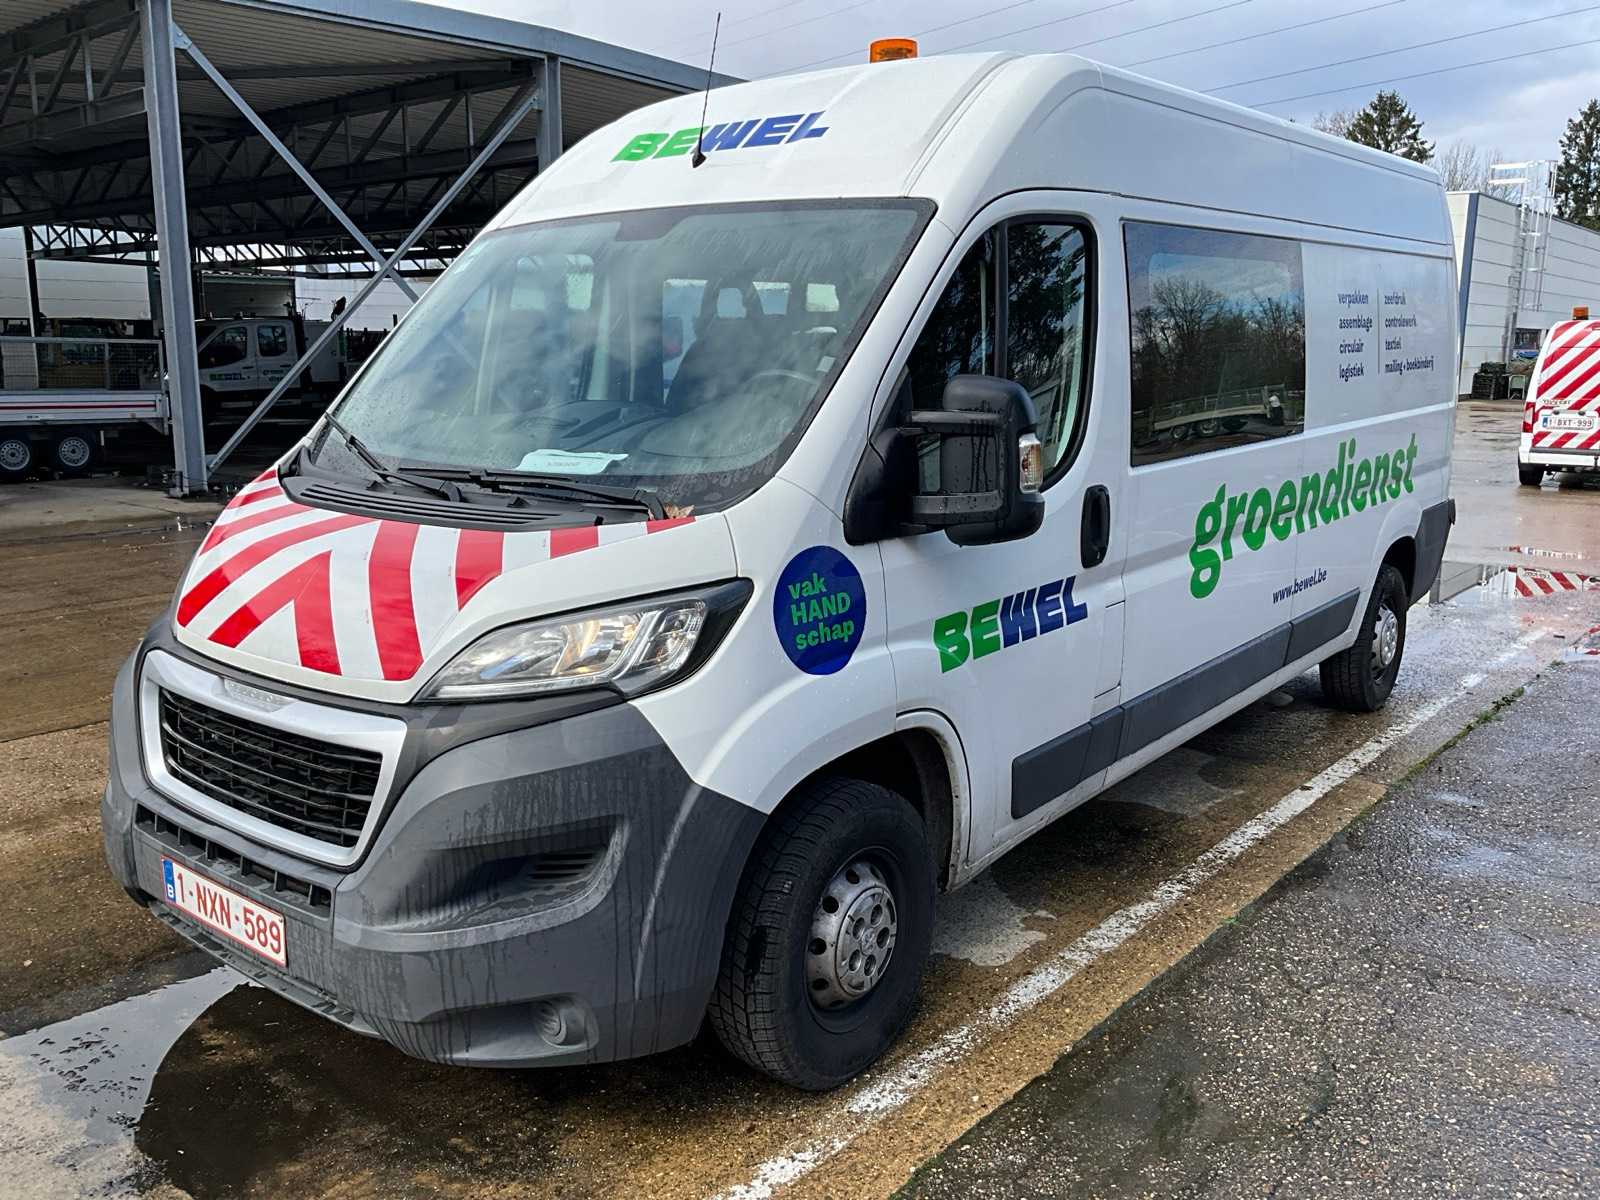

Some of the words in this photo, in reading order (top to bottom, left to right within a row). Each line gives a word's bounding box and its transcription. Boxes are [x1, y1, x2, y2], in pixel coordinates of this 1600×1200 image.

[609, 111, 830, 163] BEWEL
[1337, 290, 1369, 309] verpakken
[1384, 291, 1406, 305] zeefdruk
[1339, 314, 1373, 332] assemblage
[1384, 314, 1417, 328] controlewerk
[1339, 339, 1364, 354] circulair
[1385, 337, 1402, 351] textiel
[1339, 362, 1364, 382] logistiek
[1385, 359, 1403, 375] mailing
[1406, 355, 1434, 371] boekbinderij
[1189, 433, 1418, 599] groendienst
[788, 572, 827, 599] vak
[1272, 567, 1327, 604] www.bewel.be
[791, 592, 851, 625] HAND
[796, 620, 854, 651] schap
[933, 575, 1088, 673] BEWEL
[177, 872, 281, 954] 1-NXN-589
